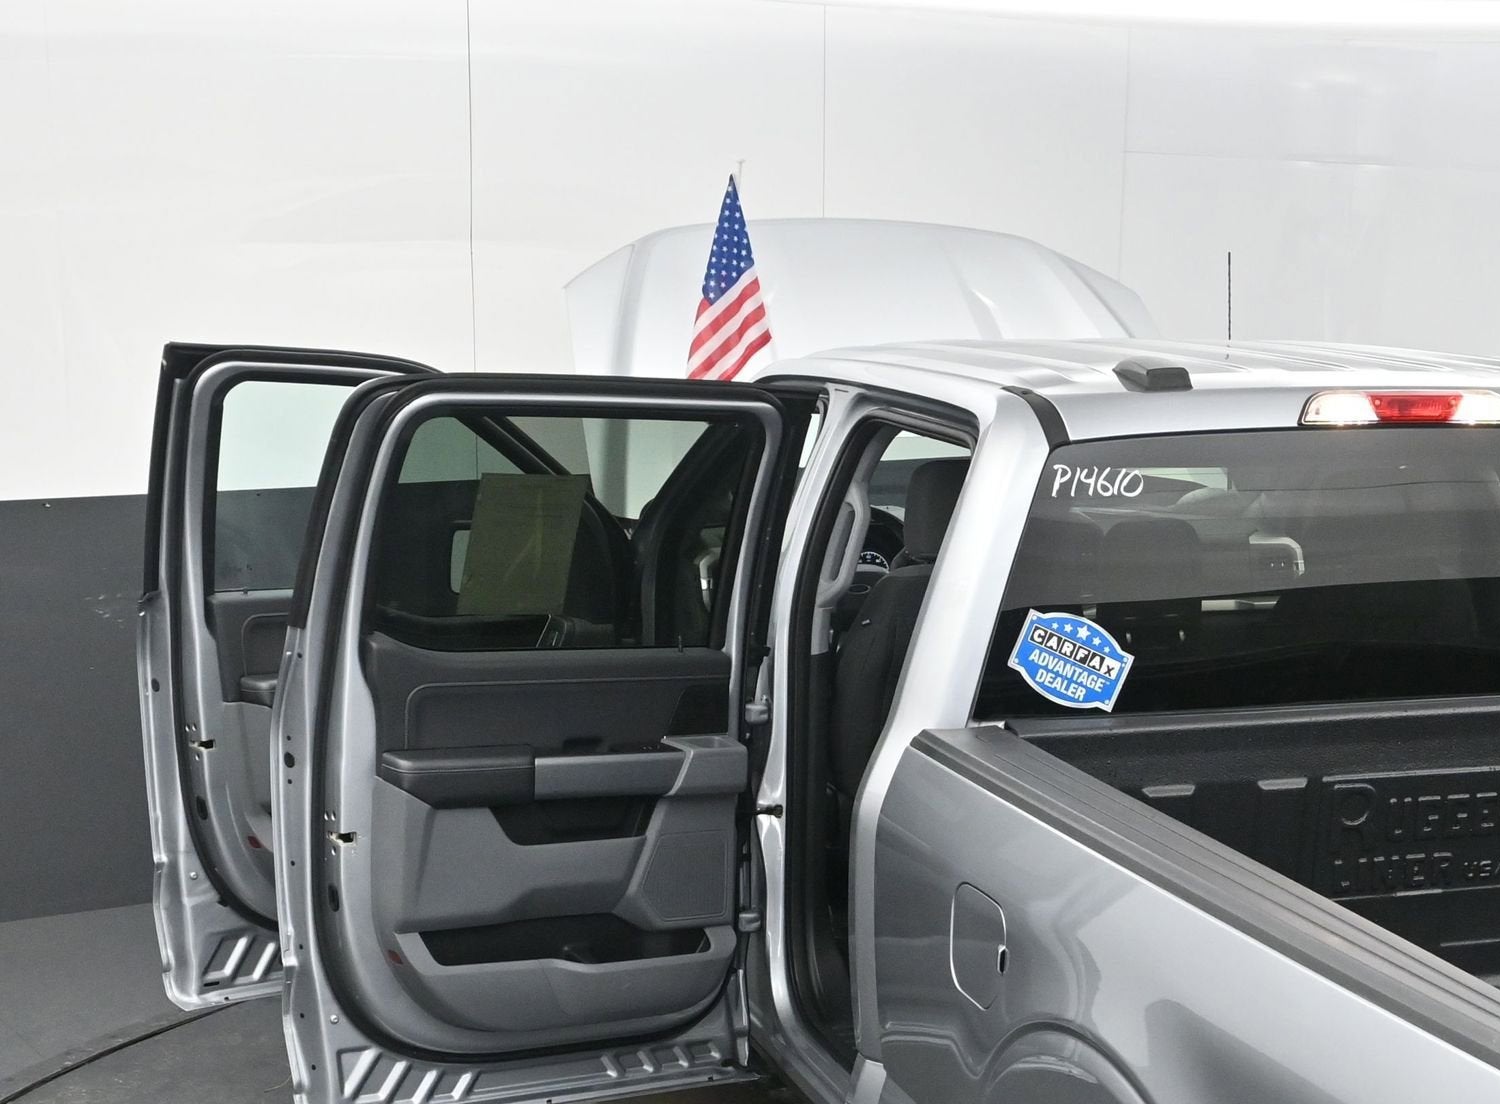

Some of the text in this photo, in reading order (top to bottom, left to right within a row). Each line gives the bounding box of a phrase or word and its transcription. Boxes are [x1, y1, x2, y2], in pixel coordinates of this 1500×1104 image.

[1051, 463, 1144, 498] P14610
[1029, 649, 1106, 693] ADVANTAGE
[1031, 626, 1118, 679] CARFAX
[1035, 668, 1087, 701] DEALER
